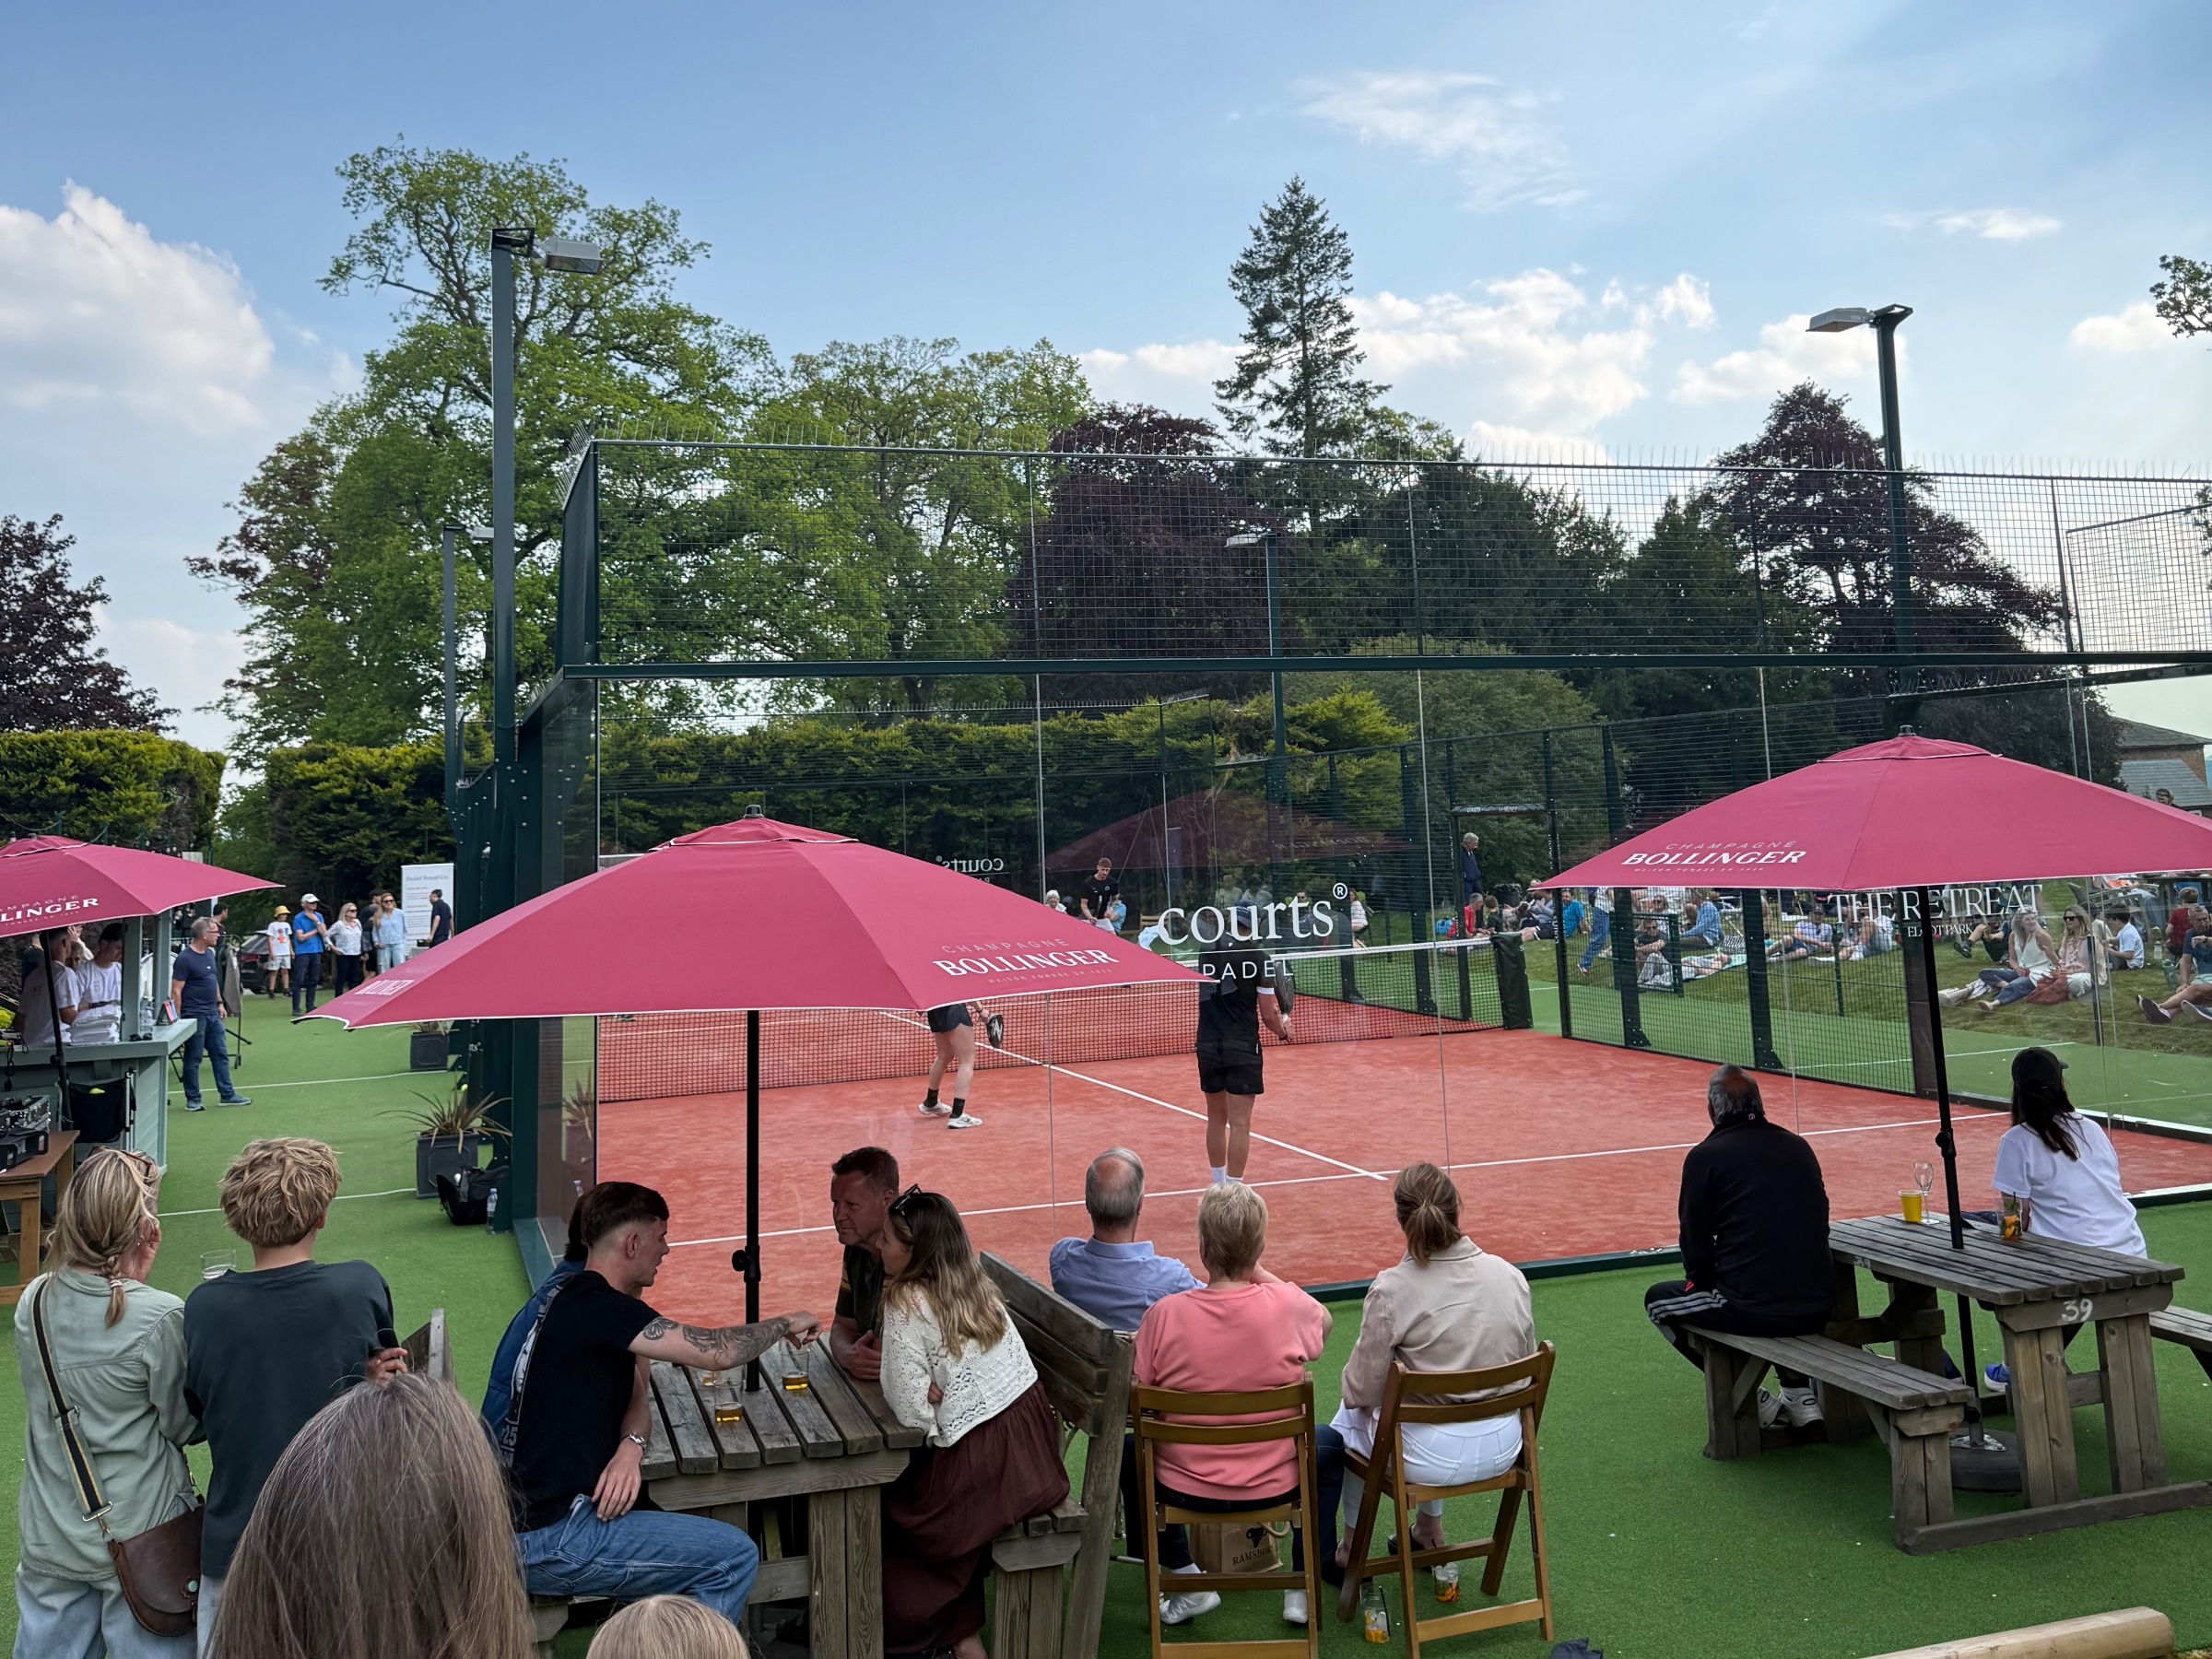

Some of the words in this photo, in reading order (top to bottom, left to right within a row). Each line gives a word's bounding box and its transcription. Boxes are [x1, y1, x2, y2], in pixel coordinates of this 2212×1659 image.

[1665, 841, 1796, 850] CHAMPAGNE
[1621, 851, 1806, 865] BOLLINGER
[1828, 891, 1897, 924] THE
[1900, 883, 2043, 922] RETREAT
[1946, 923, 1973, 935] PARK
[941, 938, 1069, 954] CHAMPAGNE
[933, 949, 1121, 976] BOLLINGER
[1202, 959, 1294, 981] PADEL
[2061, 1297, 2093, 1323] 39
